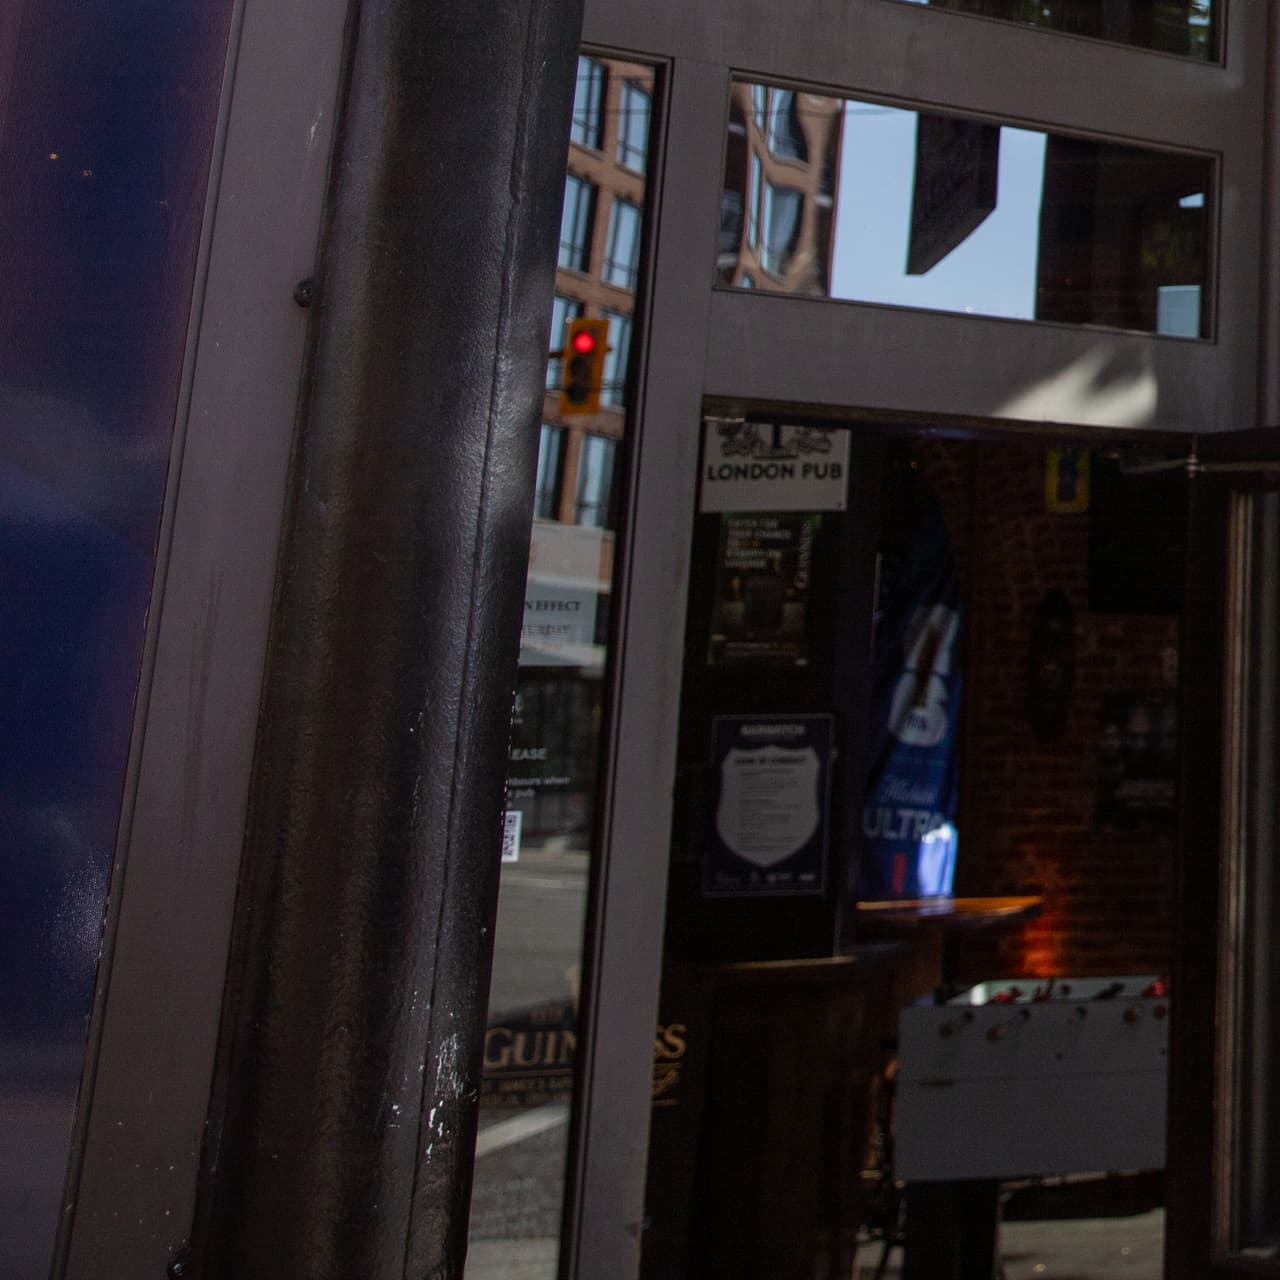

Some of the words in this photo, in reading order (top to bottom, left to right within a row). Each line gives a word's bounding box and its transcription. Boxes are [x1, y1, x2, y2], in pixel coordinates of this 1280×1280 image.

[708, 463, 795, 480] LONDON
[801, 462, 841, 479] PUB
[536, 601, 581, 612] EFFECT
[511, 748, 546, 761] EASE
